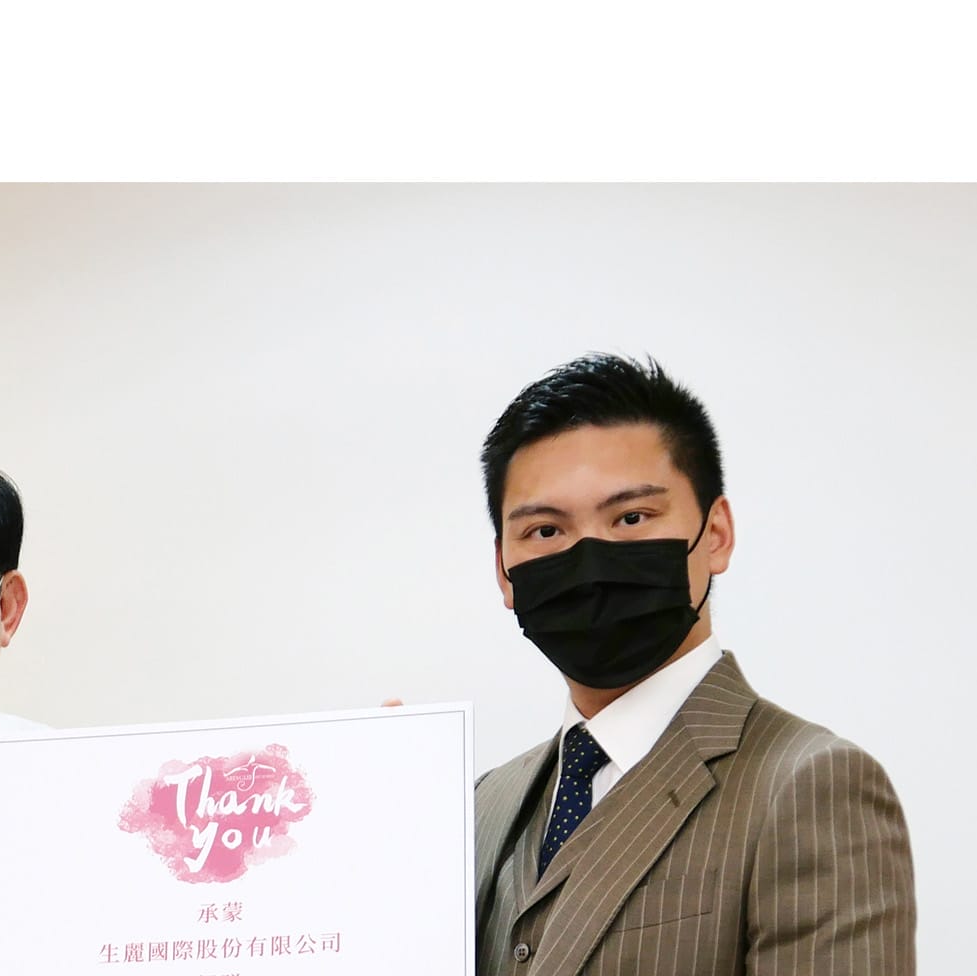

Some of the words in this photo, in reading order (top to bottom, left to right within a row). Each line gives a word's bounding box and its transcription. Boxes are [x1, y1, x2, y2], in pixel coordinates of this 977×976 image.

[164, 764, 308, 829] Thank
[184, 821, 274, 873] you
[197, 901, 244, 924] 承蒙
[98, 932, 343, 965] 生麗國際股份有限公司
